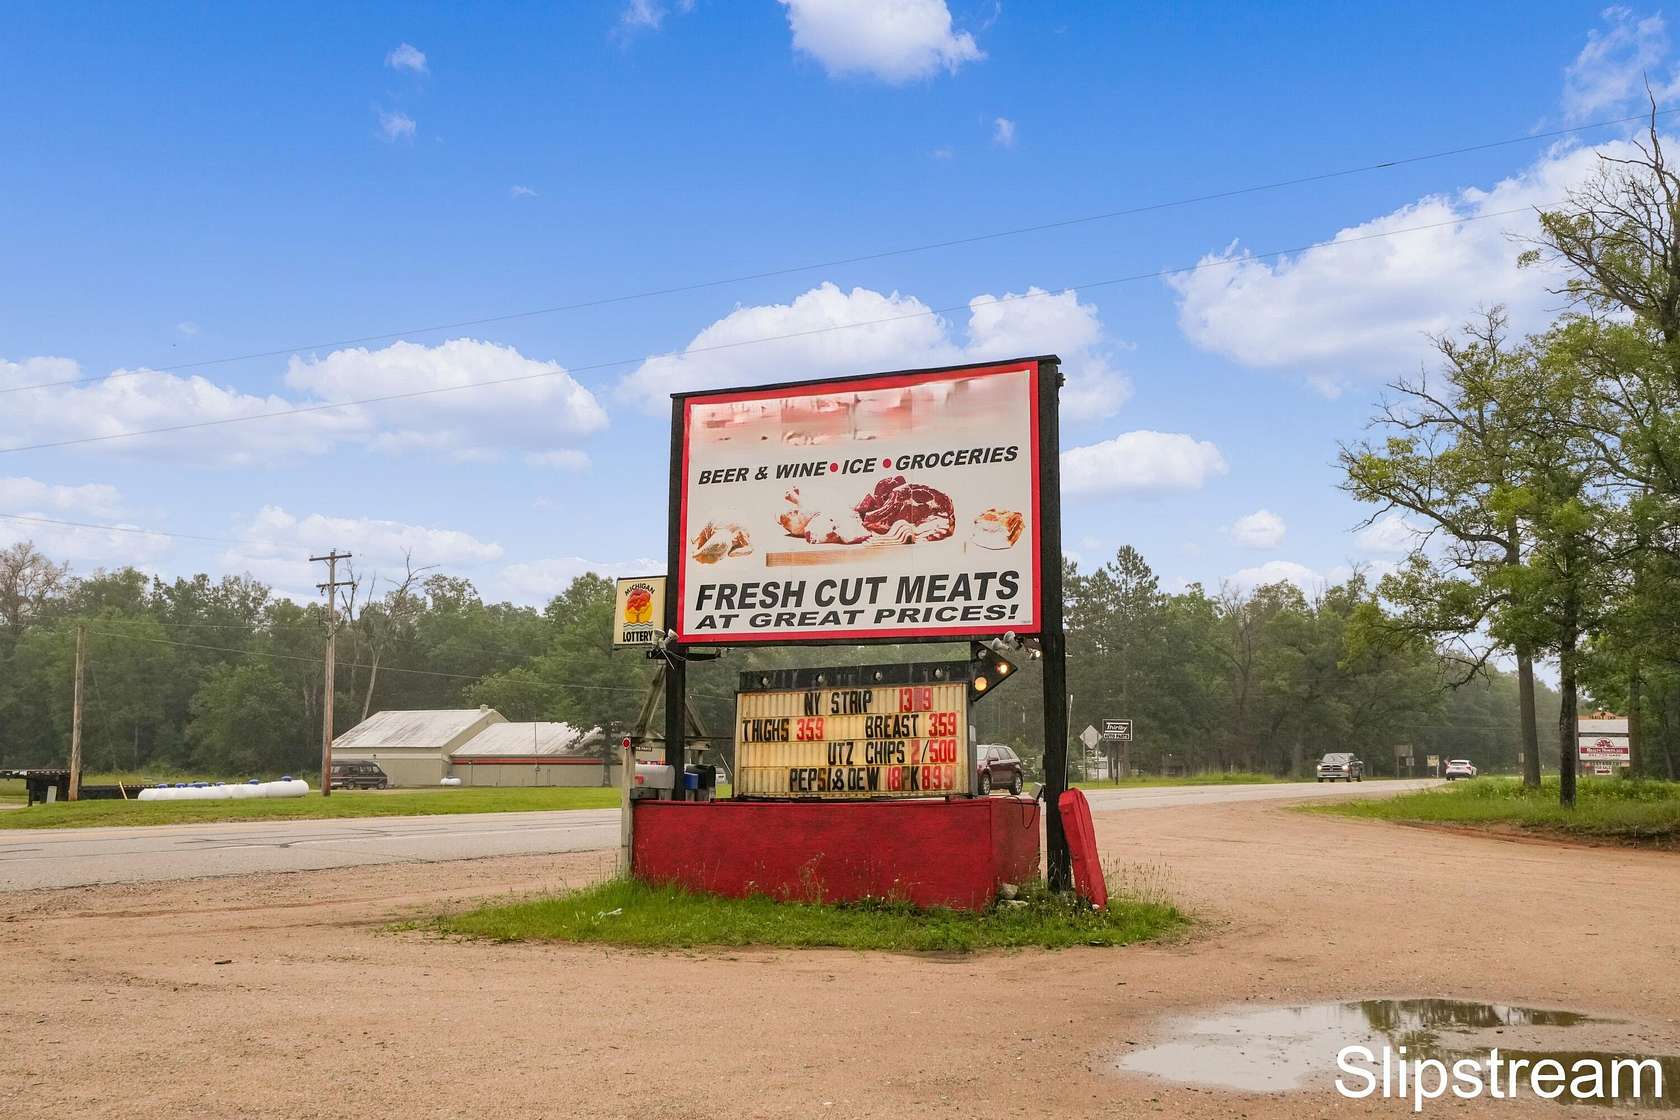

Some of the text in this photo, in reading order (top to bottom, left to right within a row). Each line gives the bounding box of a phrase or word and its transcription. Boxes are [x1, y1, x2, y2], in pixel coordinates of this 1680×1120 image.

[698, 445, 1020, 486] BEER & WINE ICE GROCERIES
[624, 582, 656, 596] MICHIGAN
[696, 570, 1020, 611] FRESH CUT MEATS
[695, 603, 1020, 630] AT GREAT PRICES!
[622, 630, 654, 642] LOTTERY
[804, 692, 821, 716] NY
[831, 690, 873, 714] STRIP
[742, 712, 957, 742] THIGHS 359 BREAST 359
[827, 742, 854, 765] UTZ
[865, 740, 905, 764] CHIPS
